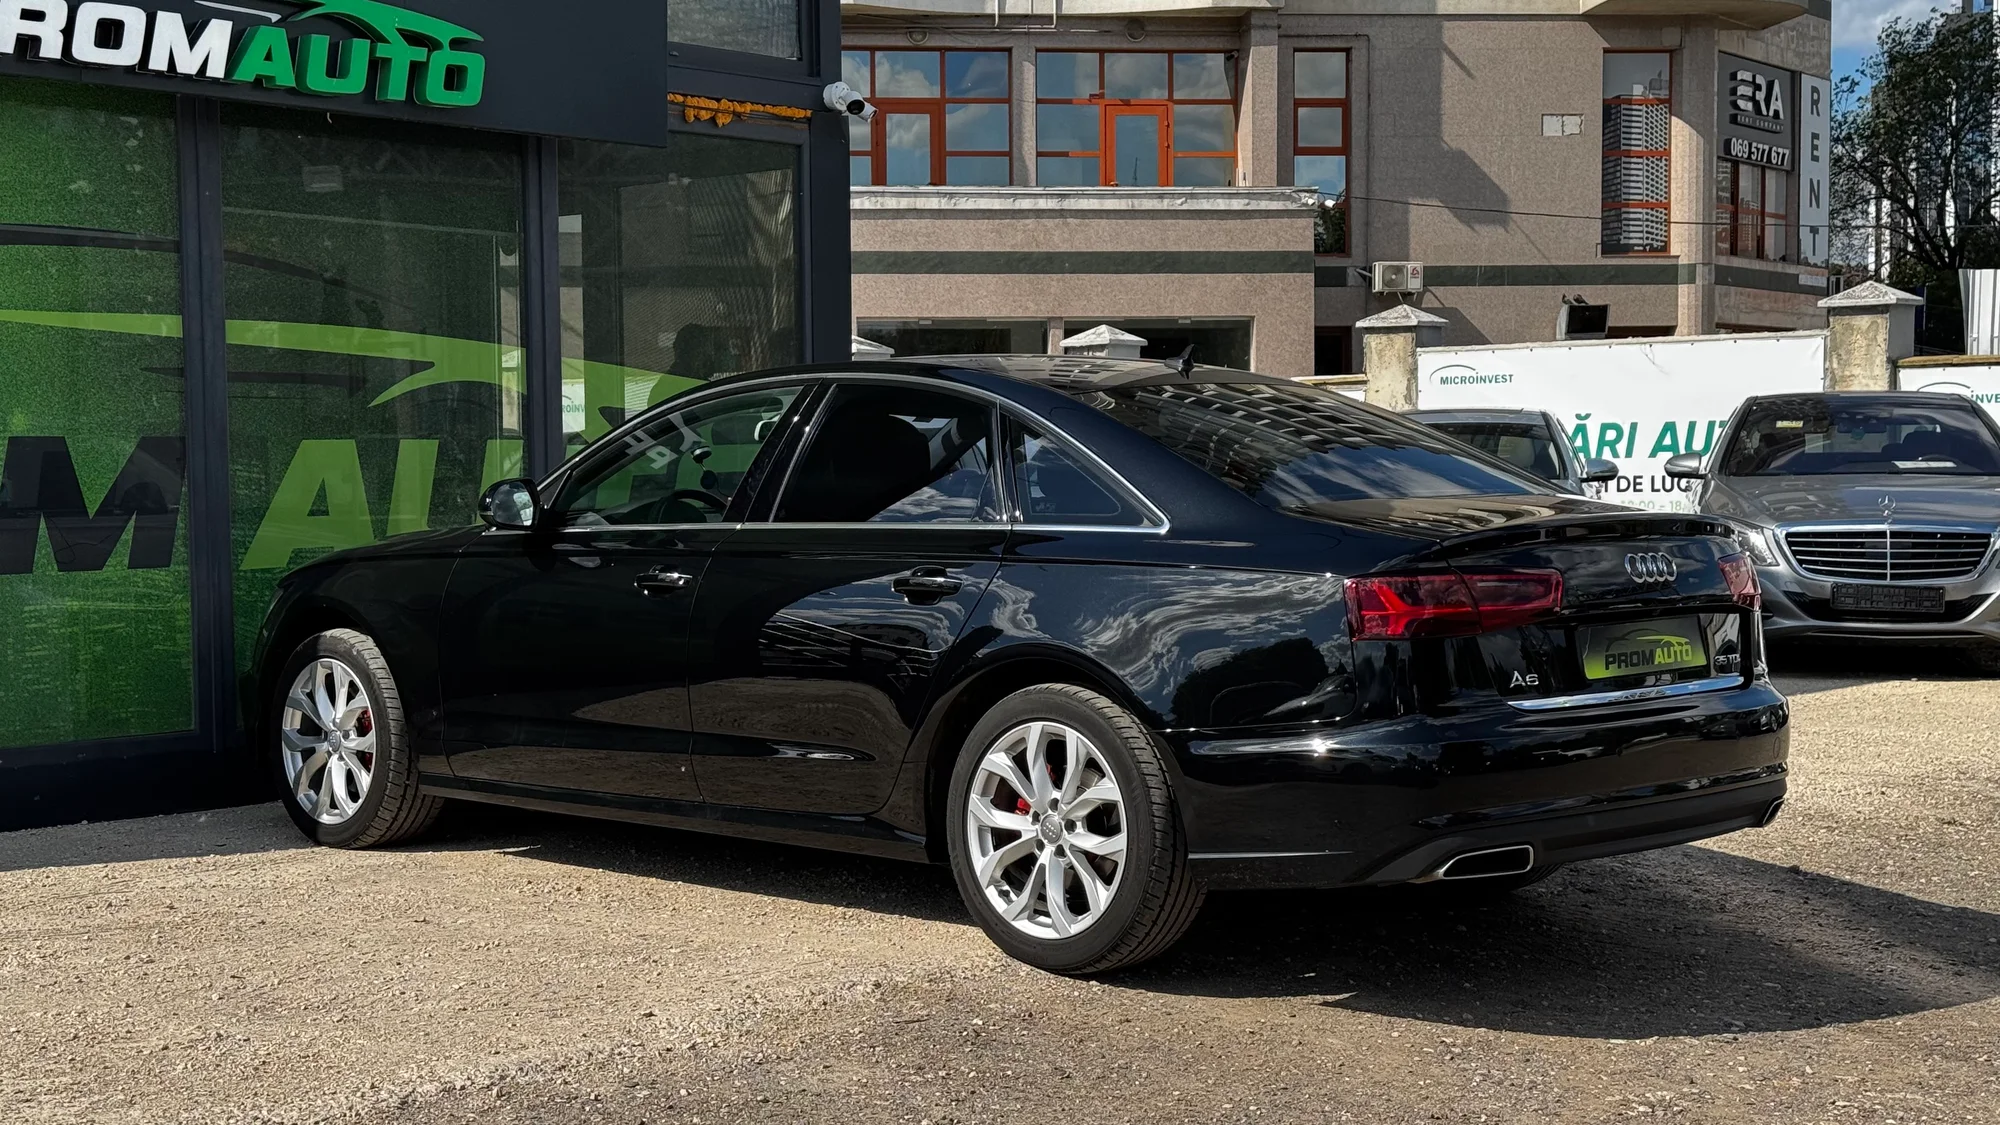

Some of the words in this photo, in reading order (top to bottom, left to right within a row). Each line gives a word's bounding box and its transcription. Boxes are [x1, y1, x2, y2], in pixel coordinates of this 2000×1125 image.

[1736, 70, 1784, 120] ERA
[1730, 137, 1749, 159] 069
[1751, 142, 1770, 163] 577
[1771, 146, 1790, 167] 677
[1809, 85, 1821, 256] RENT
[1648, 420, 1730, 459] AU
[1616, 475, 1644, 493] DE
[1604, 643, 1692, 671] PROMAUTO
[1714, 655, 1727, 666] 35
[1509, 670, 1539, 689] A6
